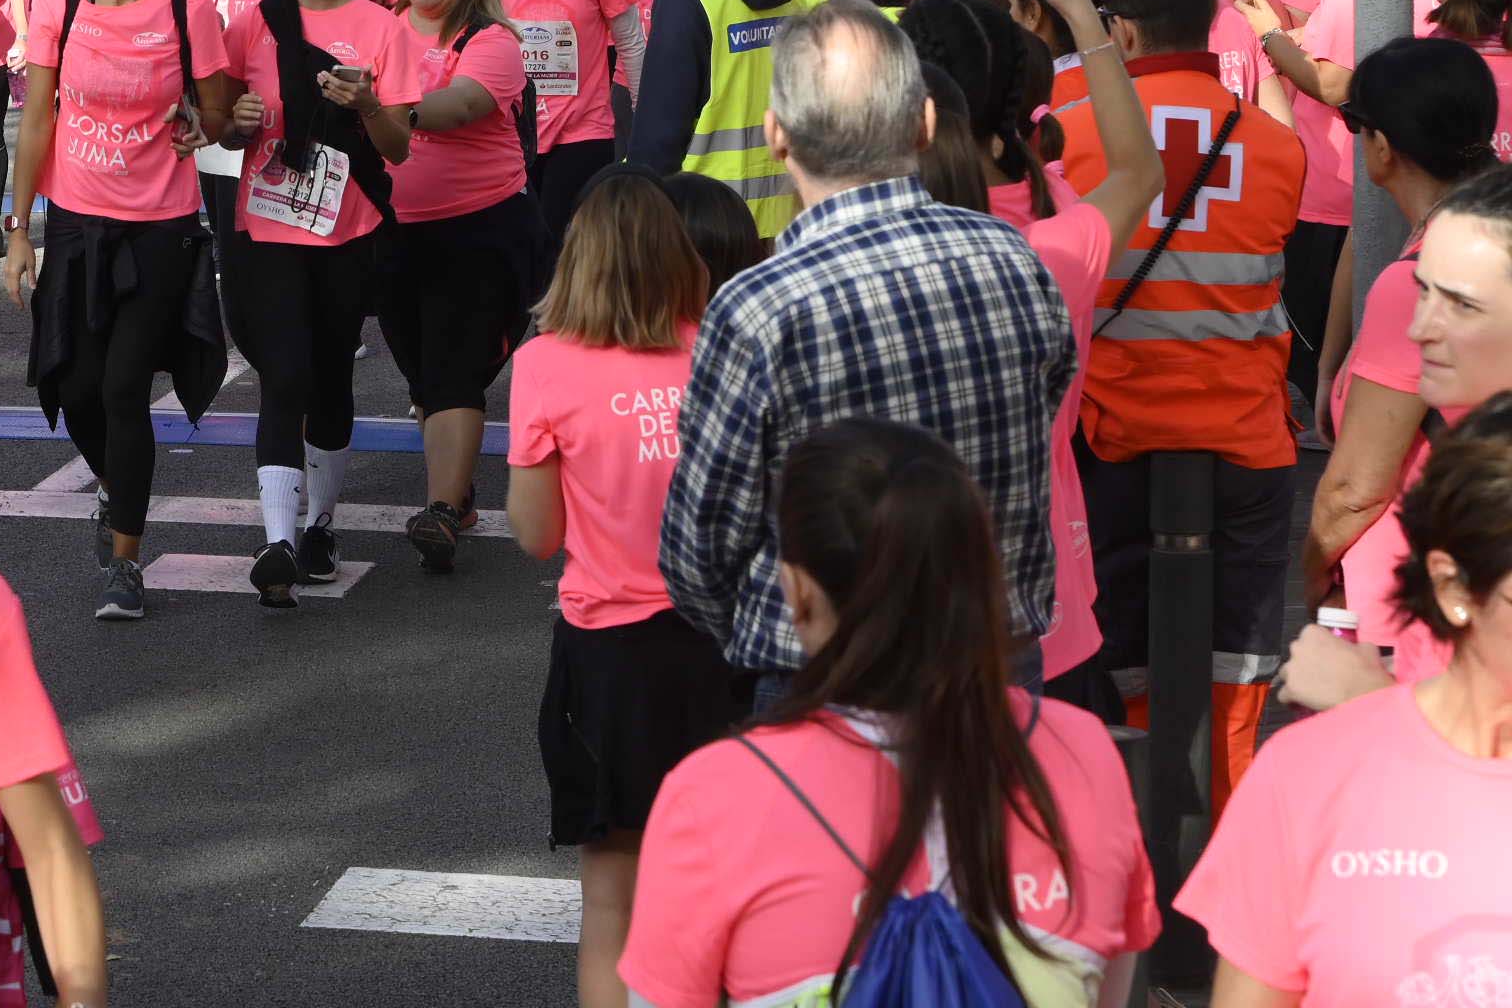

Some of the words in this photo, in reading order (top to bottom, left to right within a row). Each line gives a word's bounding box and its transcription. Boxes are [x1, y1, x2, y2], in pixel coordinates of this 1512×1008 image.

[522, 49, 550, 61] 016
[256, 202, 285, 216] OYSHO
[609, 386, 689, 417] CARR
[639, 413, 674, 435] DE
[1330, 847, 1449, 880] OYSHO
